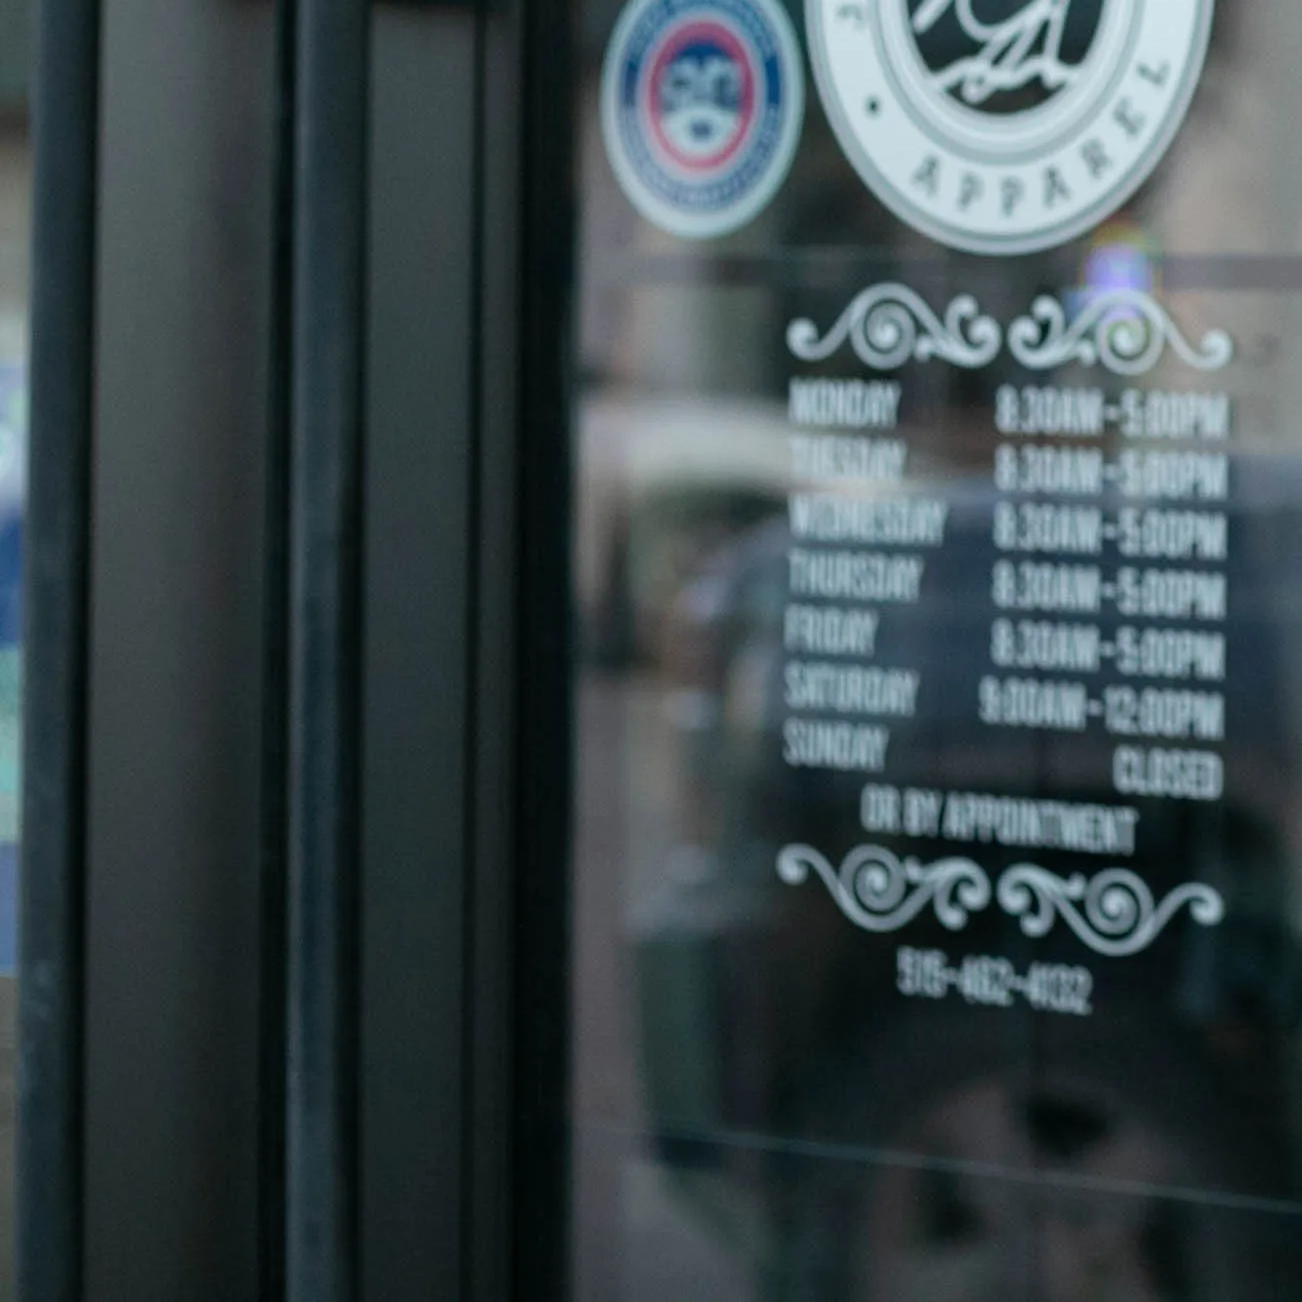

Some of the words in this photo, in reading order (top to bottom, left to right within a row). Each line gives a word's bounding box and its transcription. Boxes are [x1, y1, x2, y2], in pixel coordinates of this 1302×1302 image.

[912, 59, 1171, 218] APPAREL
[788, 377, 901, 429] MONDAY
[787, 550, 924, 603] THURSDAY
[783, 602, 879, 658] FRIDAY
[783, 659, 921, 717] SATURDAY
[782, 715, 890, 772] SUNDAY
[1112, 744, 1225, 801] CLOSED
[860, 783, 901, 832] OR
[902, 786, 943, 838] BY
[943, 790, 1140, 857] APPOINTMENT
